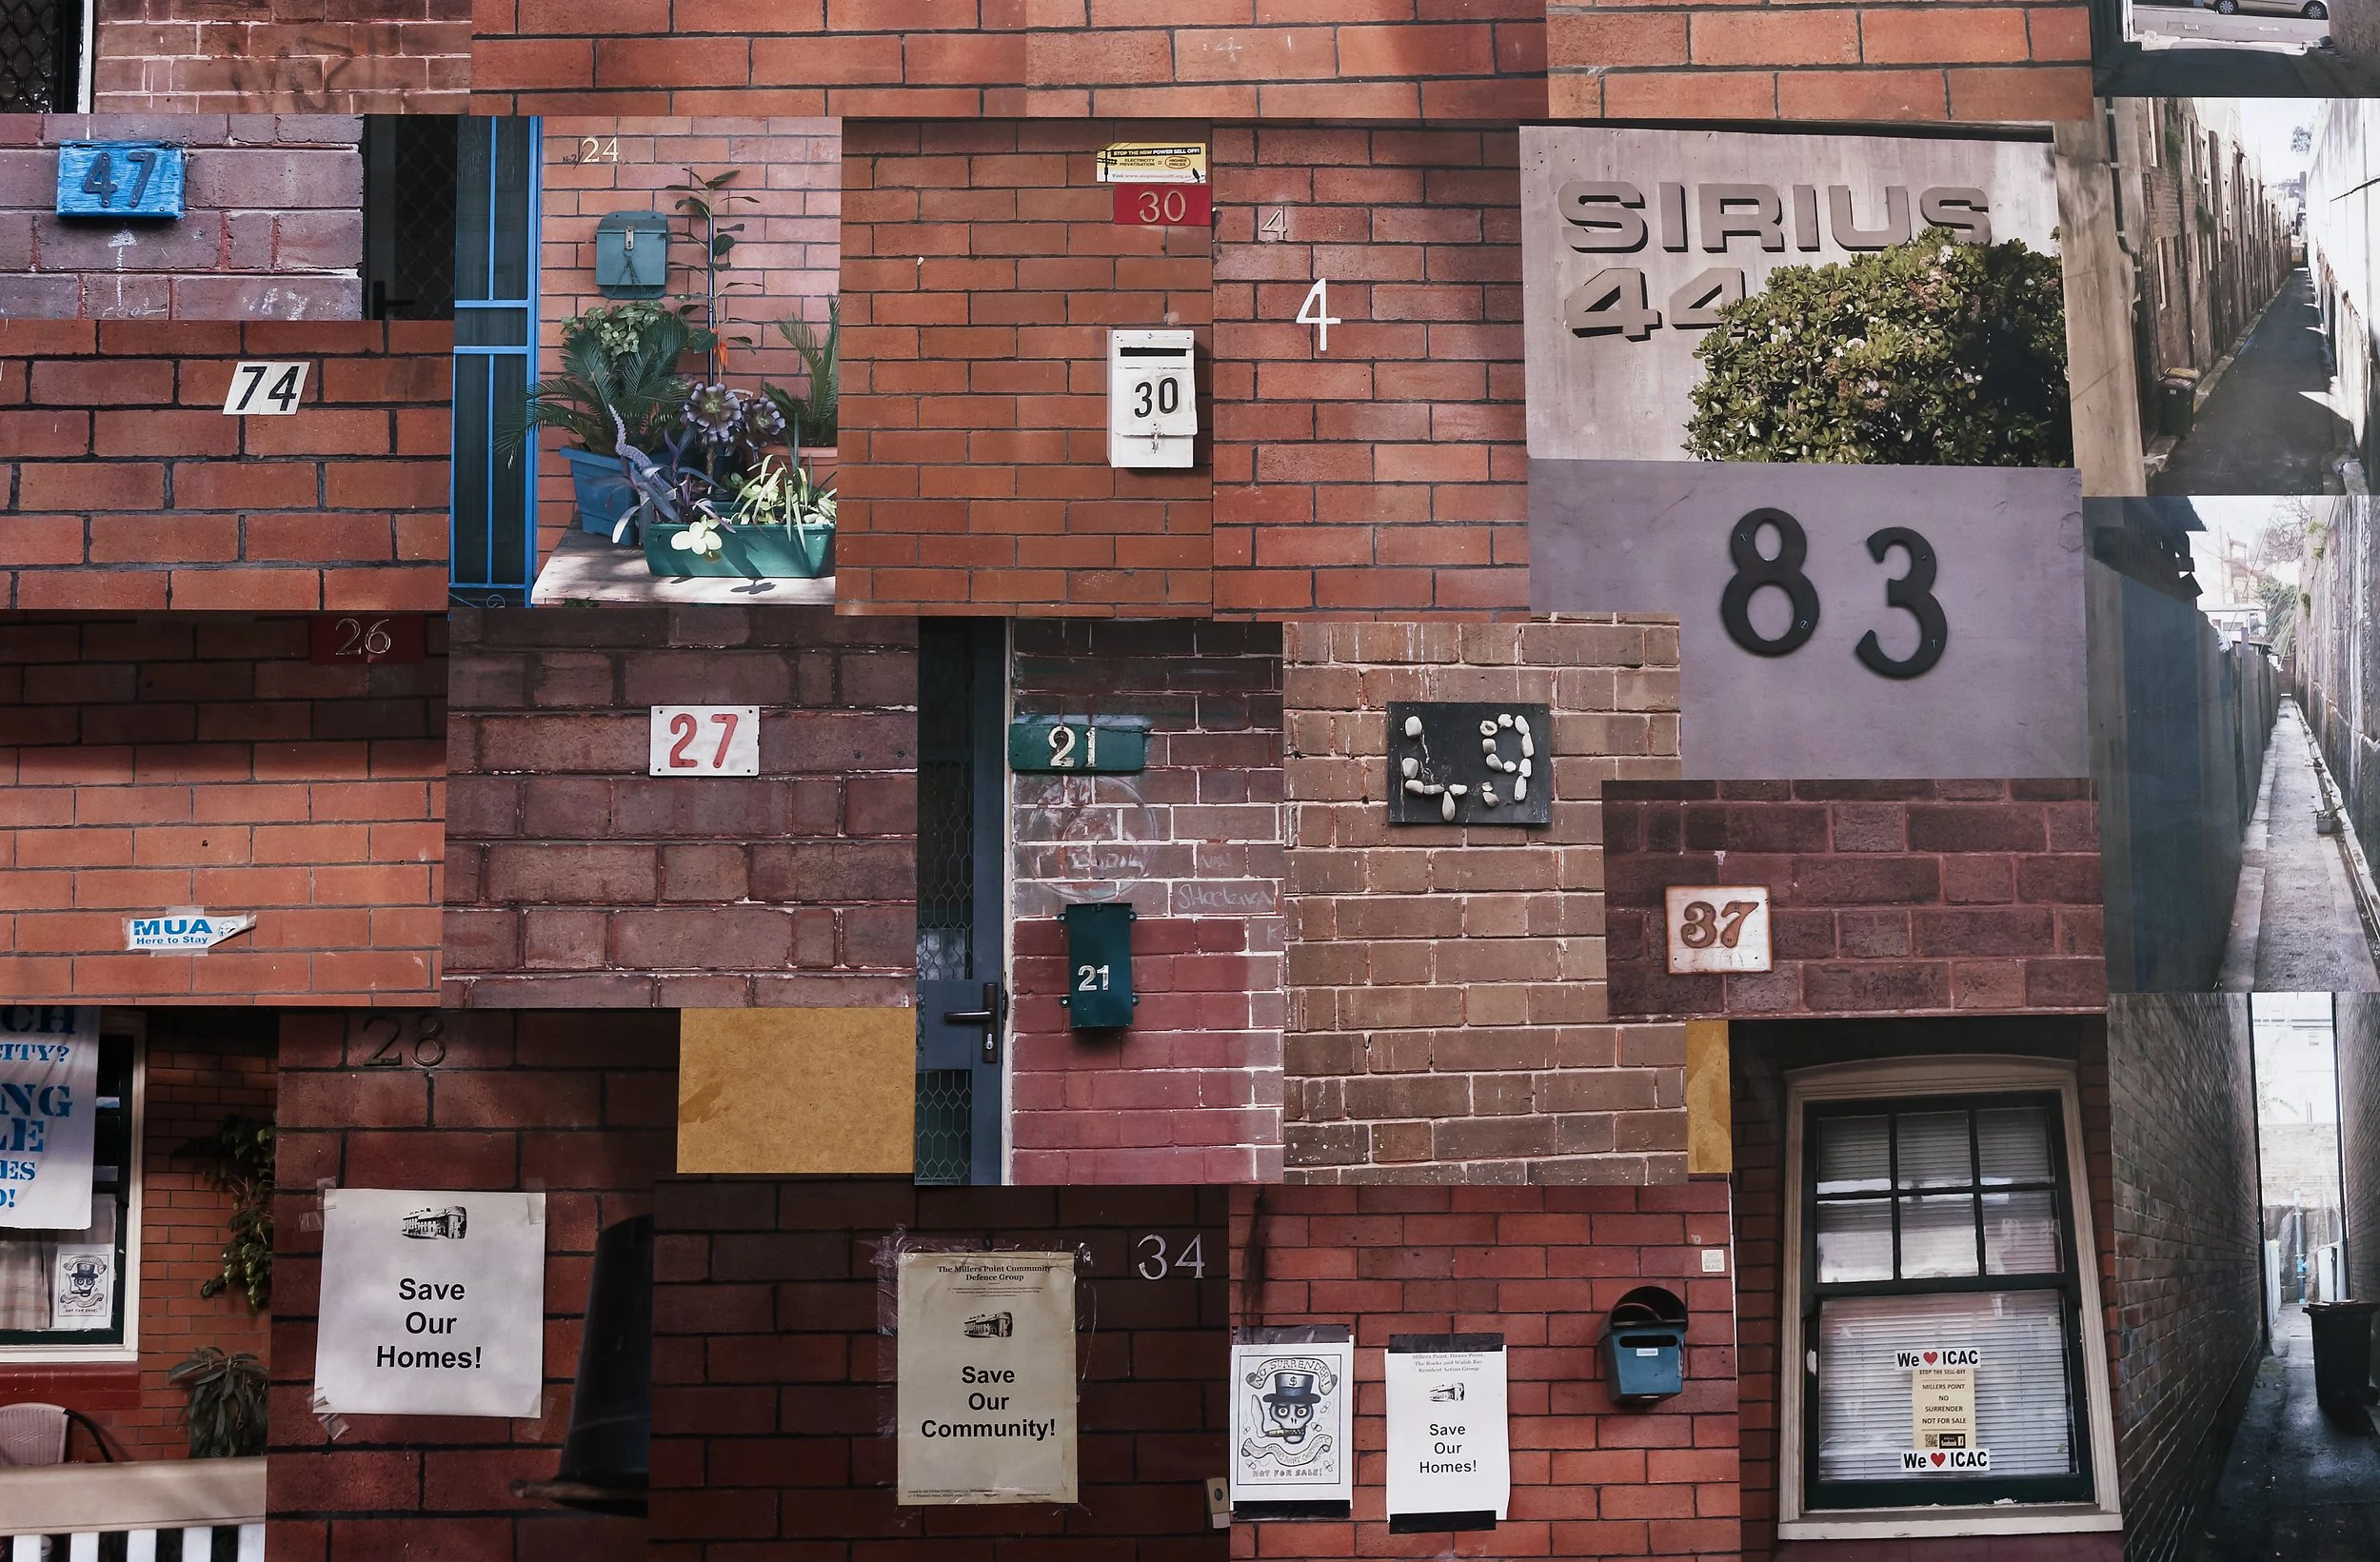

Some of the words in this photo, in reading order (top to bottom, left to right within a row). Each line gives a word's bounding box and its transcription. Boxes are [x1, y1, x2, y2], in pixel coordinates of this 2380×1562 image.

[582, 136, 620, 163] 24
[82, 151, 157, 208] 47
[1138, 191, 1186, 223] 30
[1557, 181, 1993, 253] SIRIUS
[1261, 206, 1287, 241] 4
[1296, 278, 1341, 351] 4
[236, 366, 300, 411] 74
[1134, 377, 1180, 418] 30
[335, 618, 391, 655] 26
[669, 713, 739, 768] 27
[1048, 724, 1096, 767] 21
[133, 919, 213, 936] MUA
[1680, 900, 1759, 948] 37
[136, 937, 164, 945] Here
[182, 936, 208, 945] Stay
[1078, 964, 1109, 992] 21
[0, 1043, 70, 1062] ITY?
[363, 1013, 446, 1067] 28
[0, 1117, 44, 1153] E
[1005, 1264, 1051, 1274] Community
[1138, 1234, 1205, 1280] 34
[399, 1277, 466, 1301] Save
[999, 1274, 1024, 1282] Group
[406, 1312, 457, 1335] Our
[376, 1345, 482, 1369] Homes!
[1897, 1352, 1920, 1367] We
[1942, 1350, 1978, 1366] ICAC
[962, 1366, 1015, 1384] Save
[1255, 1369, 1267, 1386] NO
[1270, 1359, 1331, 1388] SURRENDER!
[968, 1393, 1010, 1411] Our
[921, 1418, 1056, 1441] Community!
[1429, 1423, 1466, 1436] Save
[1434, 1442, 1462, 1454] Our
[1903, 1453, 1927, 1469] We
[1950, 1452, 1988, 1468] ICAC
[1274, 1469, 1292, 1477] FOR
[1295, 1468, 1323, 1477] SALE!
[1419, 1459, 1477, 1473] Homes!
